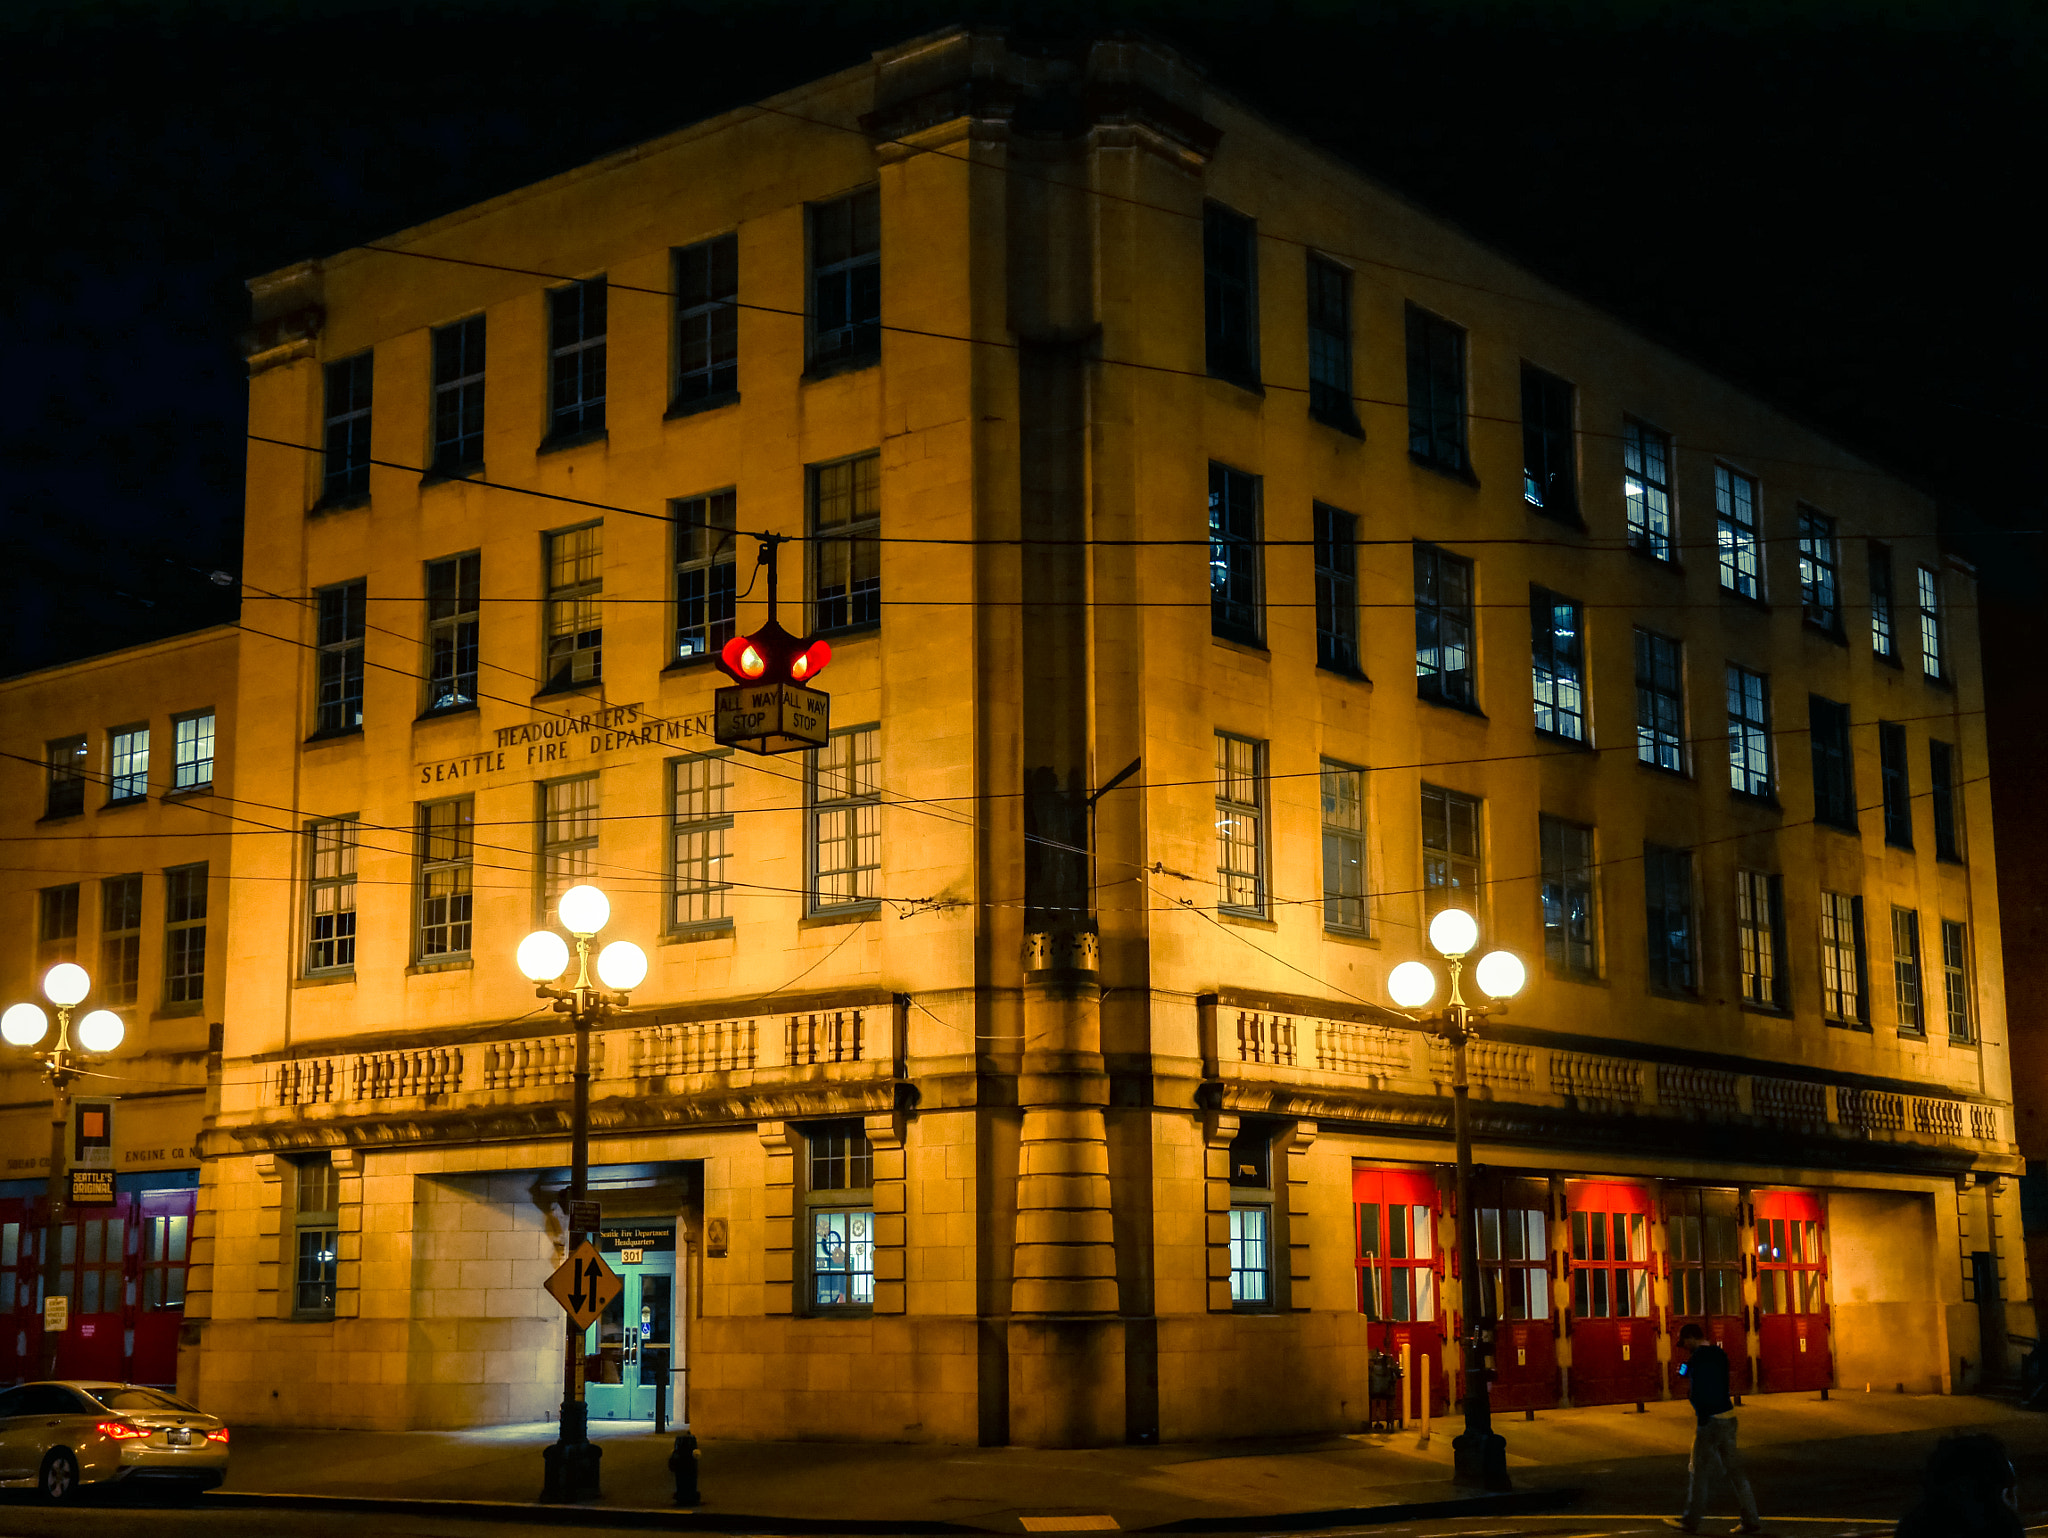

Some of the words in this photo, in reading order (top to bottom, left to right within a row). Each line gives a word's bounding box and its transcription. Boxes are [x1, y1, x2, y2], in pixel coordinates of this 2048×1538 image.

[720, 697, 743, 712] ALL
[752, 691, 778, 708] WAY
[783, 691, 801, 709] ALL
[806, 697, 826, 716] WAY
[497, 706, 638, 748] HEADQUARTERS
[732, 712, 766, 730] STOP
[793, 713, 816, 731] STOP
[421, 753, 505, 784] SEATTLE
[527, 741, 568, 765] FIRE
[125, 1149, 166, 1162] ENGINE
[73, 1172, 113, 1183] SEATTLE'S
[73, 1183, 113, 1194] ORIGINAL
[600, 1229, 619, 1238] Seattle
[621, 1229, 632, 1237] Fire
[635, 1229, 669, 1239] Department
[614, 1238, 655, 1248] Headquarters
[623, 1251, 640, 1262] 301
